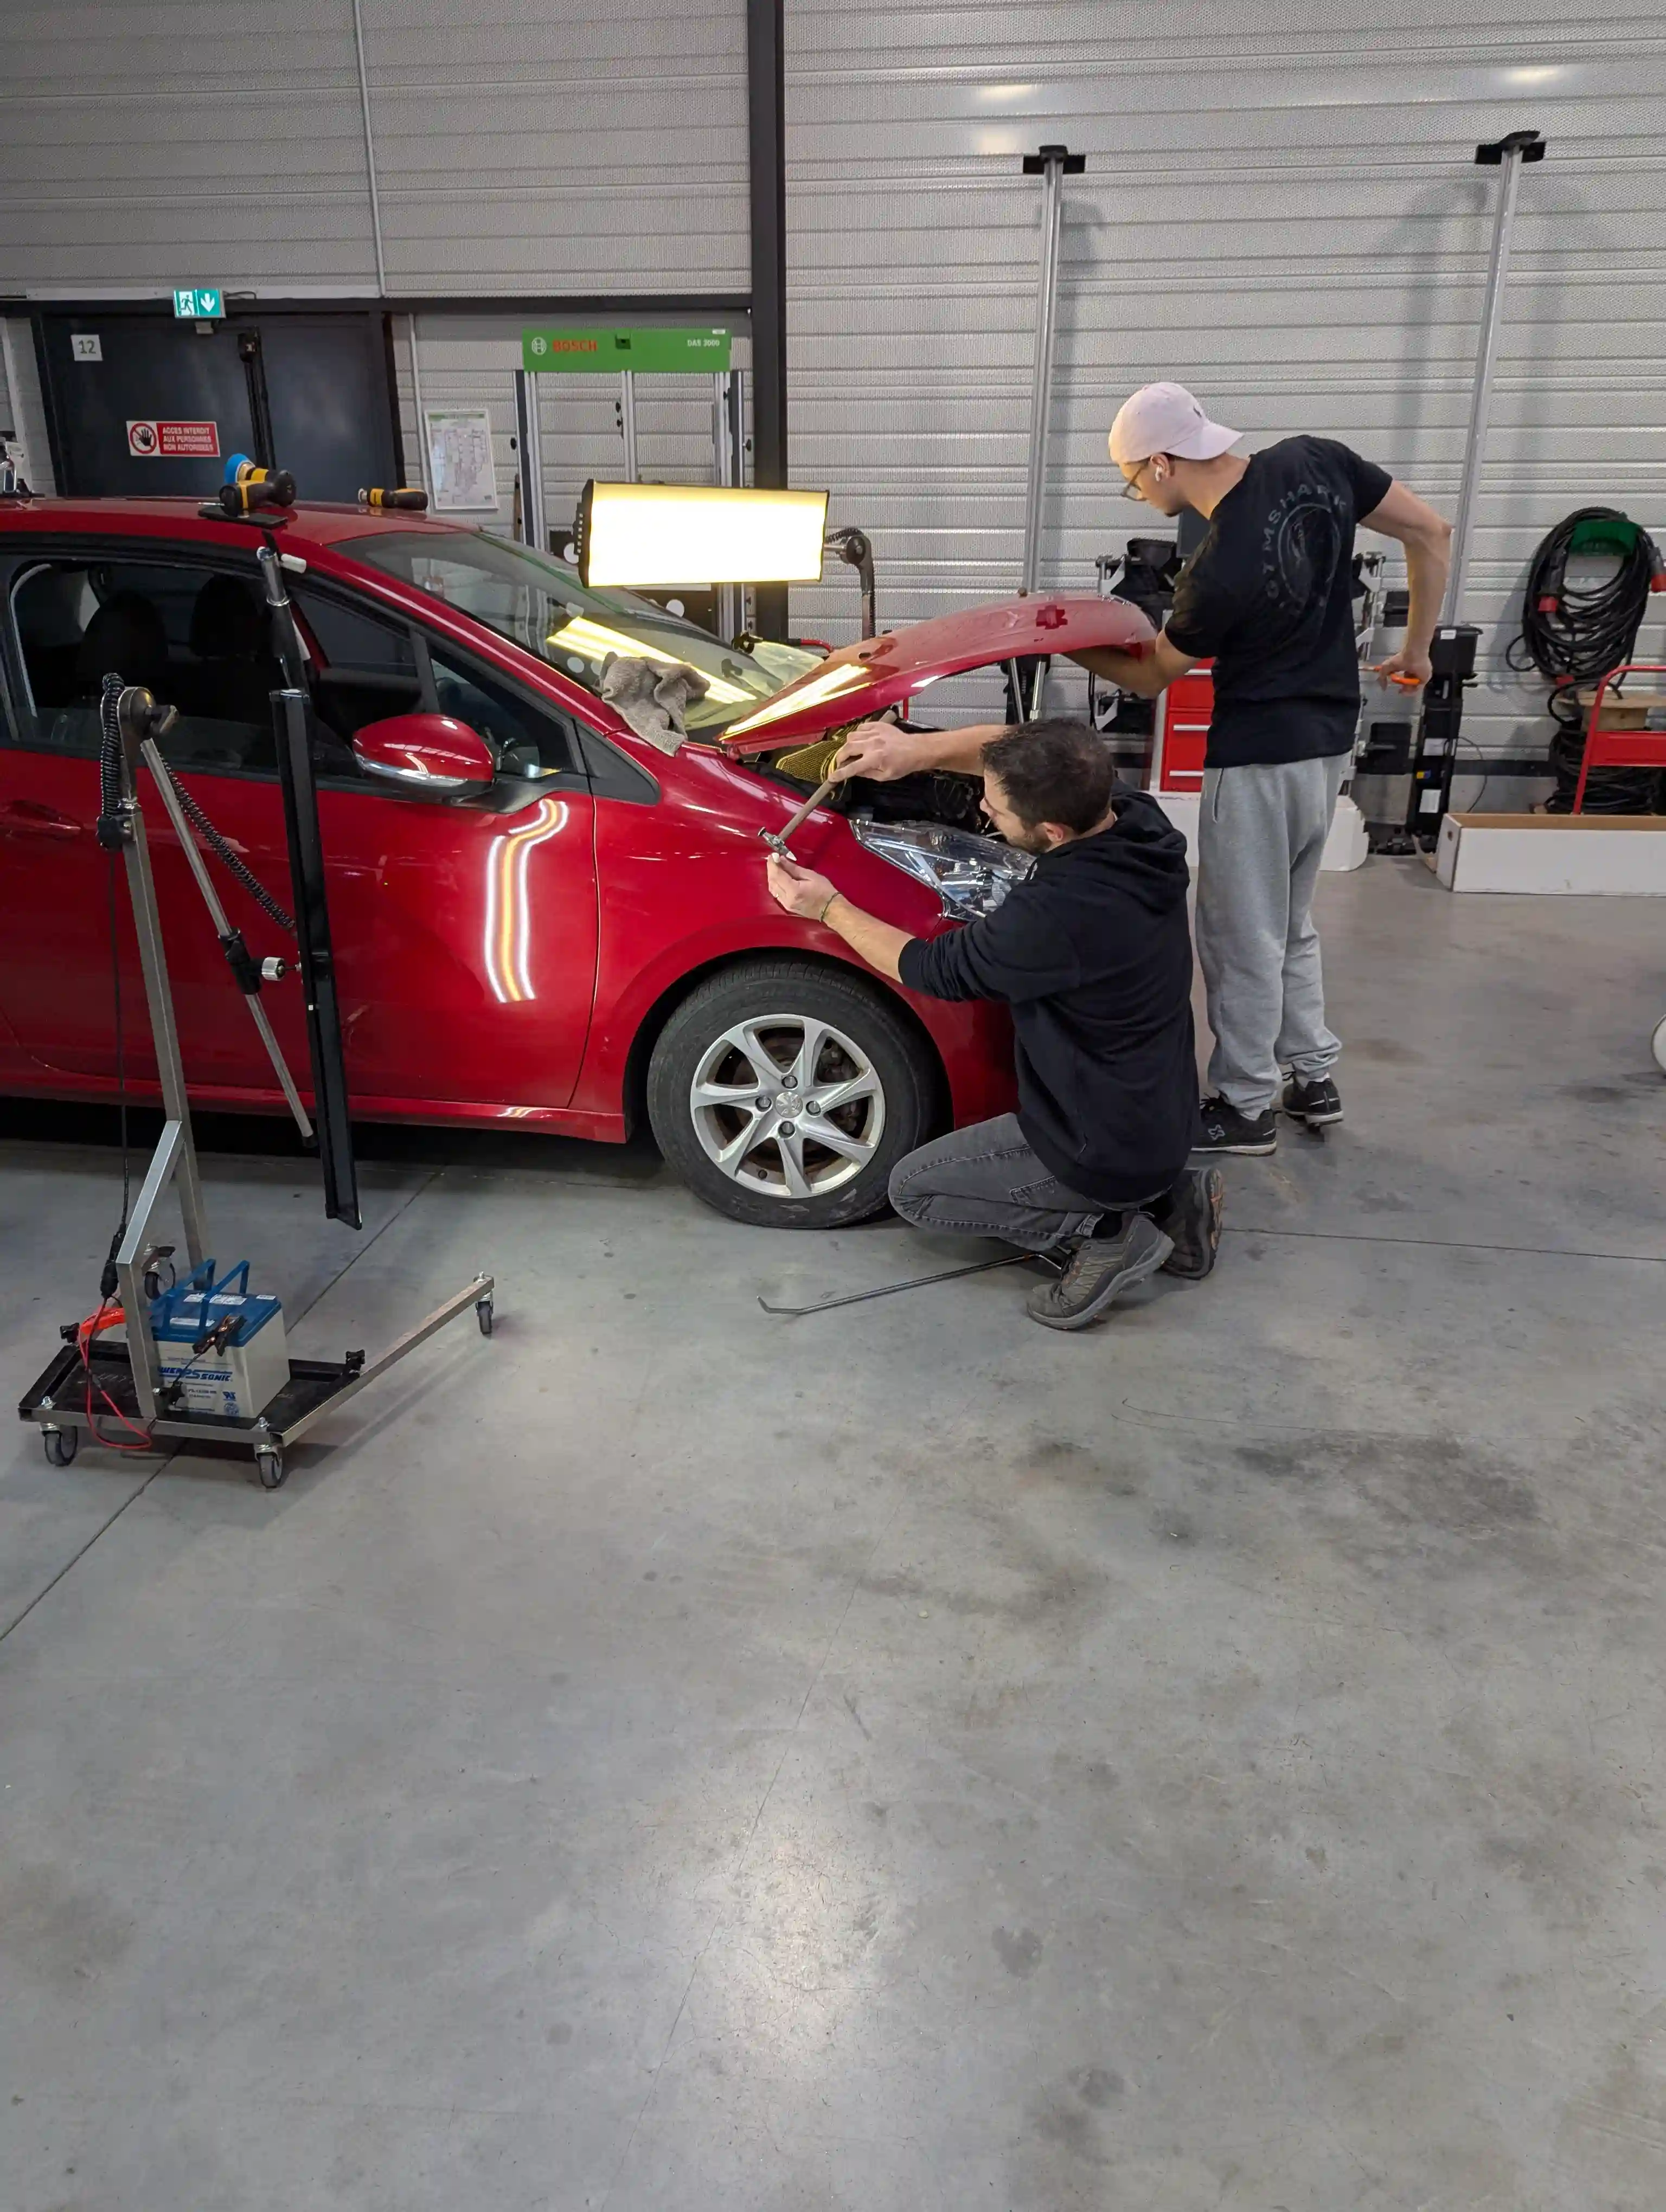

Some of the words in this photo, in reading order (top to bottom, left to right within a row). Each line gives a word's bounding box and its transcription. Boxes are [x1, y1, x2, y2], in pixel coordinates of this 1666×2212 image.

[79, 339, 96, 354] 12
[553, 339, 598, 352] BOSCH
[1263, 484, 1347, 599] GYMSHARK
[200, 1373, 231, 1381] SONIC
